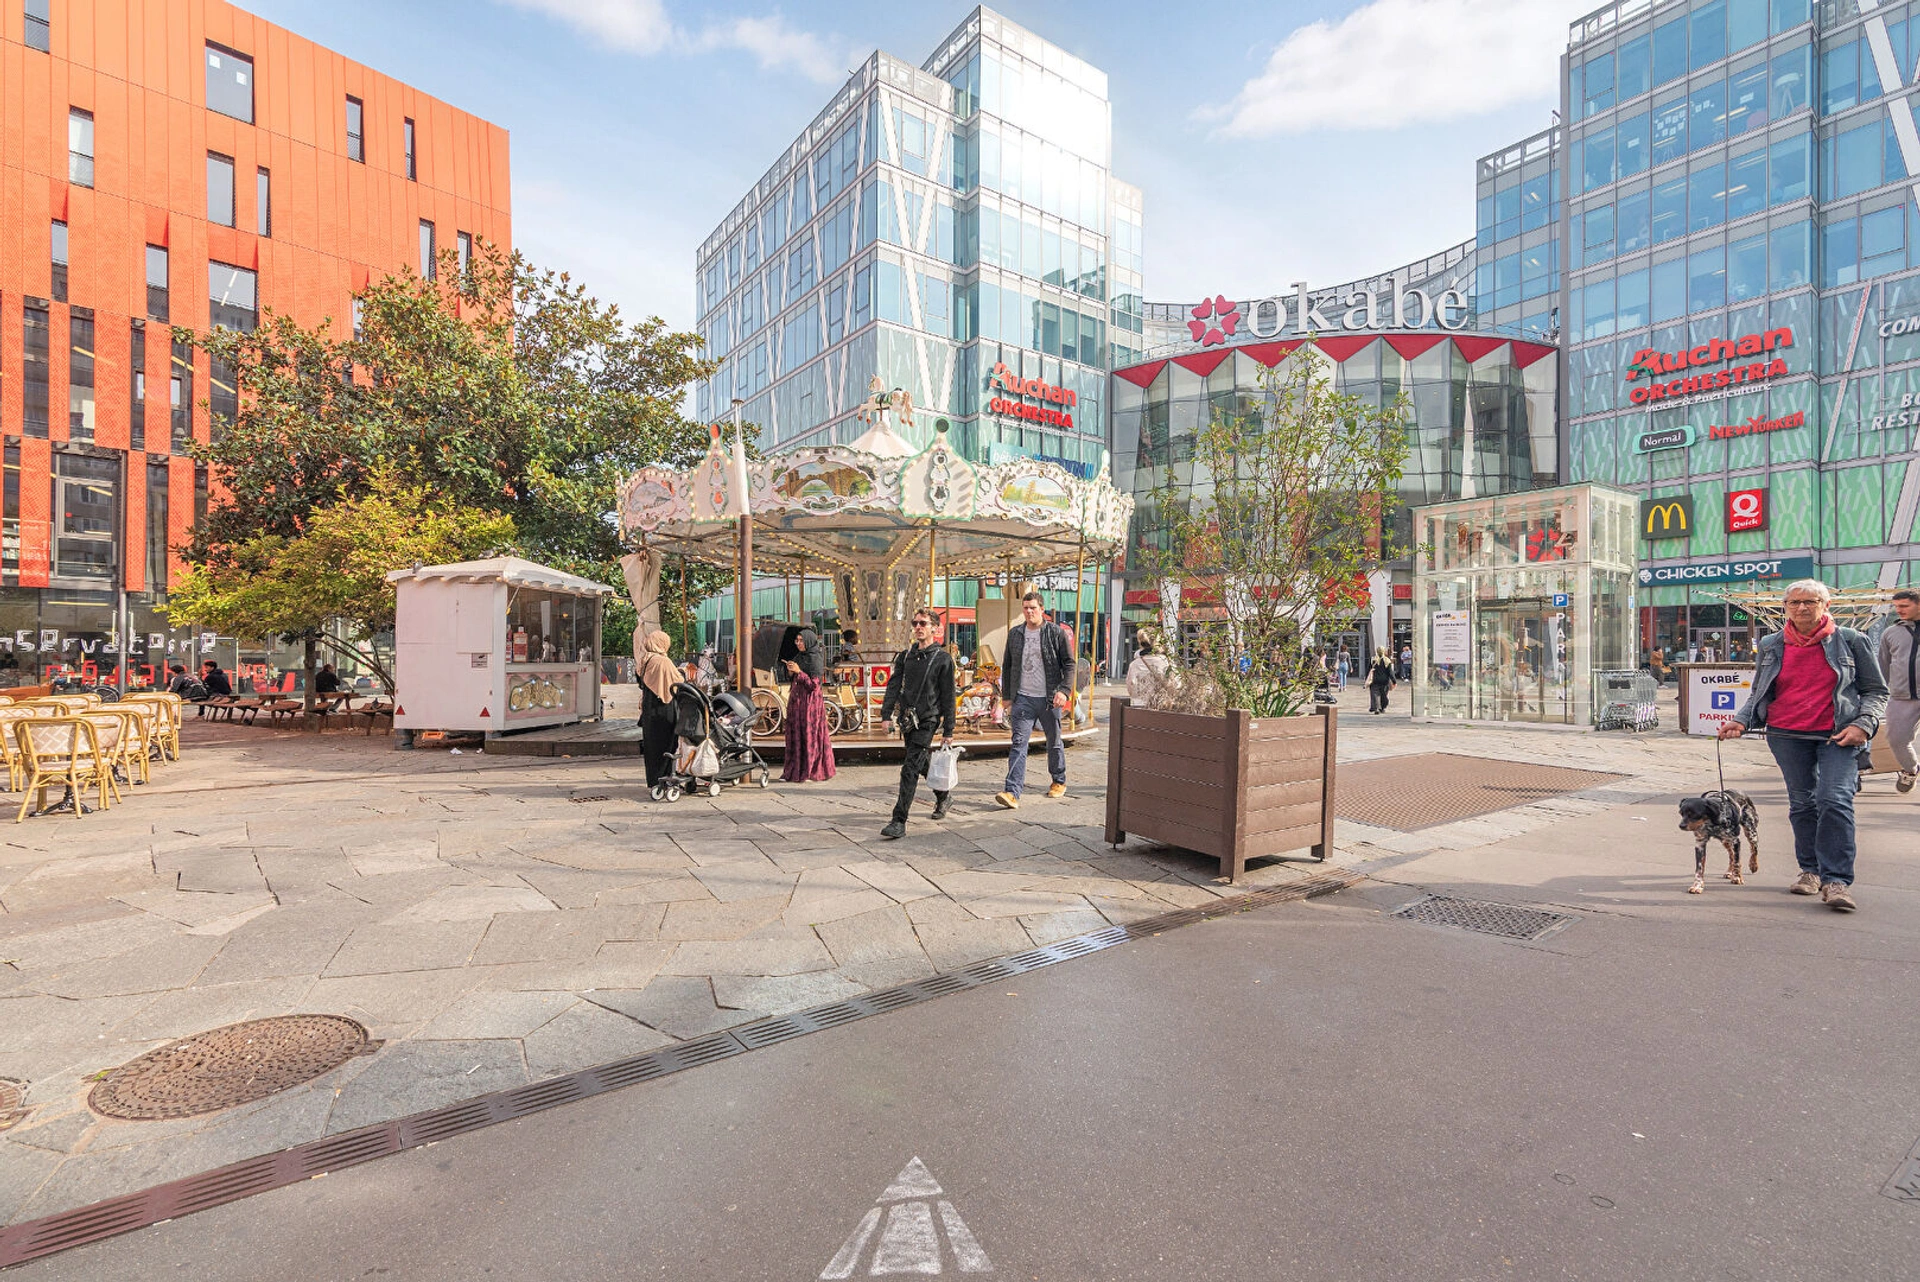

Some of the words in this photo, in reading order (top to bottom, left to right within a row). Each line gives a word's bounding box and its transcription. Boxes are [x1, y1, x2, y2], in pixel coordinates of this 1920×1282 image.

[1247, 277, 1468, 338] okabé
[1626, 327, 1793, 381] Auchan
[990, 362, 1076, 407] Auchan
[1629, 358, 1788, 403] ORCHESTRA
[990, 397, 1074, 428] ORCHESTRA
[1644, 433, 1681, 447] Normal
[1733, 518, 1758, 529] Quick
[1655, 564, 1729, 580] CHICKEN
[1734, 561, 1782, 576] SPOT
[1701, 672, 1740, 684] OKABÉ
